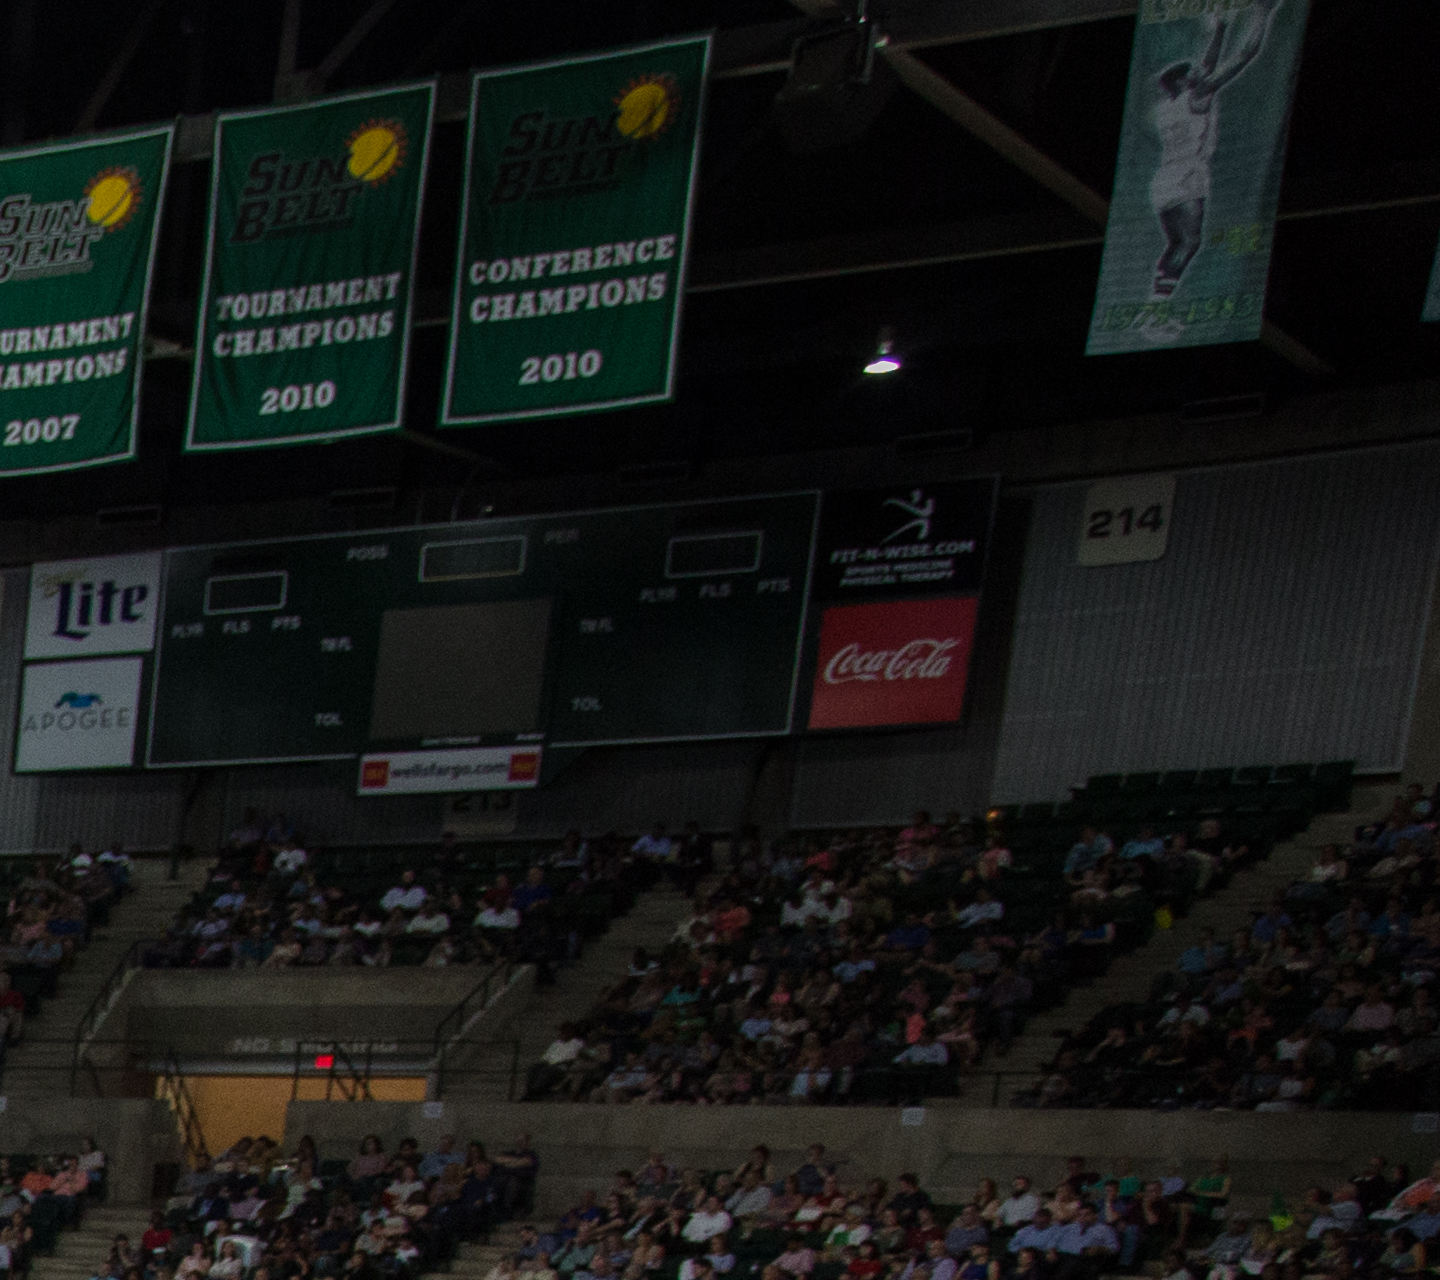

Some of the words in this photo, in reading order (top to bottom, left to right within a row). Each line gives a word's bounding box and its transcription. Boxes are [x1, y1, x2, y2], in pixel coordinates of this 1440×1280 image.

[469, 233, 677, 285] CONFERENCE
[216, 272, 402, 321] TOURNAMENT
[469, 272, 668, 324] CHAMPIONS
[213, 309, 395, 357] CHAMPIONS
[518, 349, 604, 386] 2010
[259, 381, 337, 415] 2010
[4, 414, 81, 446] 2007
[1087, 505, 1163, 538] 214
[829, 539, 977, 565] FIT-N-WISE.COM
[52, 579, 148, 641] Lite
[824, 638, 962, 685] Coca-Cola
[21, 707, 130, 733] APOGEE
[390, 761, 509, 783] wellsfargo.com
